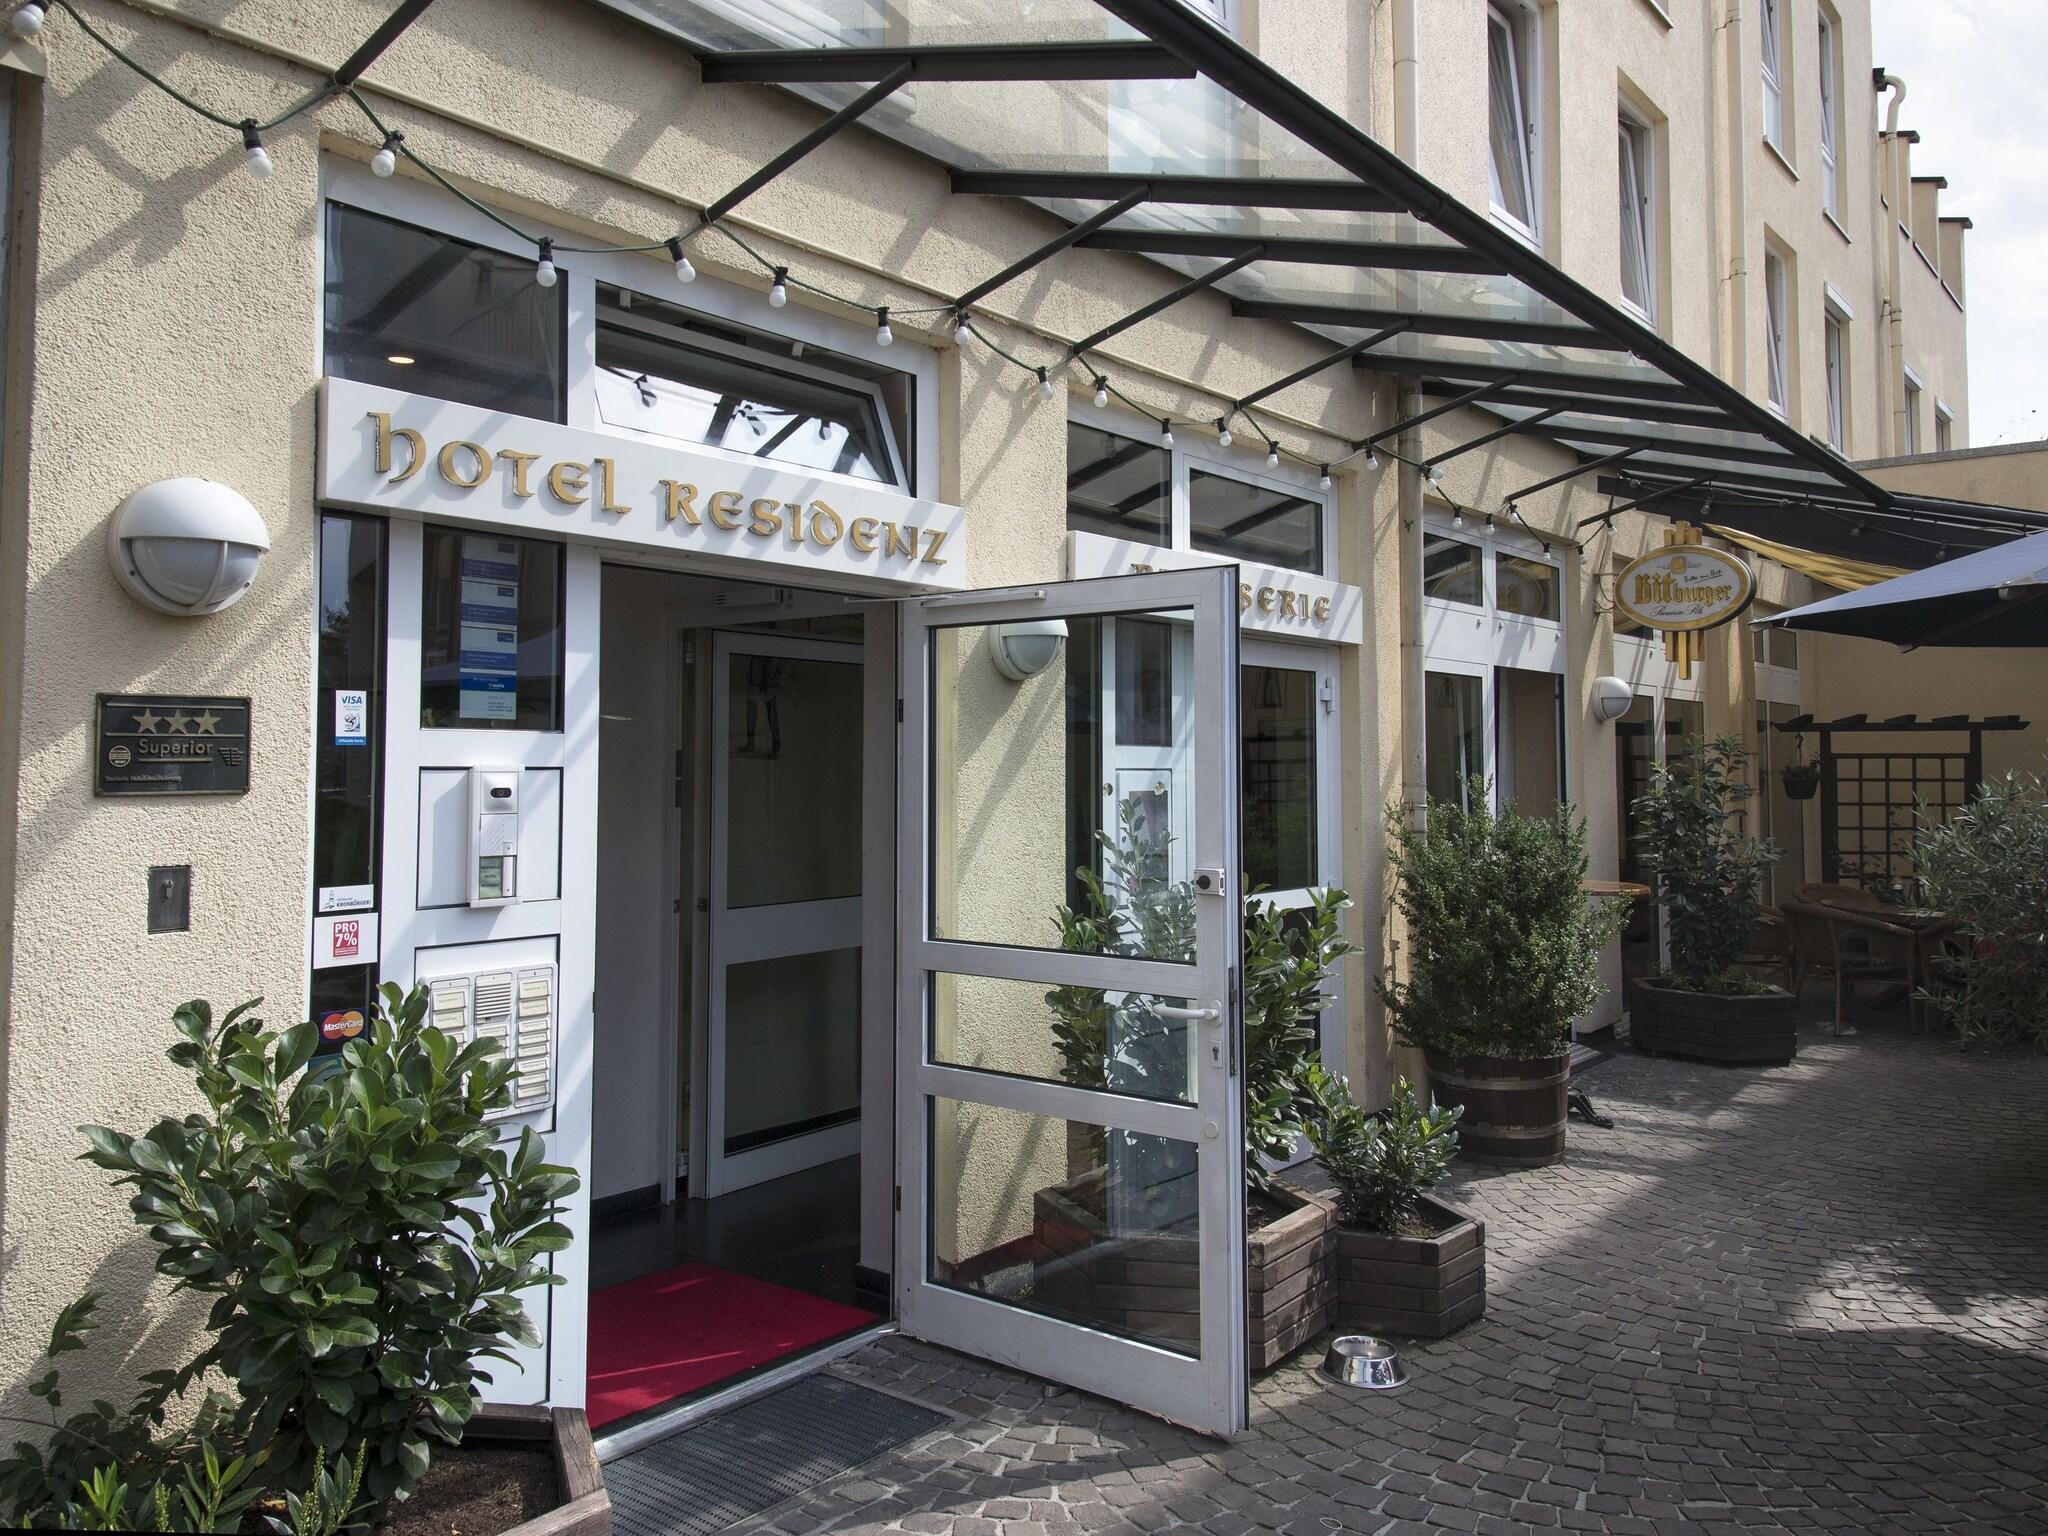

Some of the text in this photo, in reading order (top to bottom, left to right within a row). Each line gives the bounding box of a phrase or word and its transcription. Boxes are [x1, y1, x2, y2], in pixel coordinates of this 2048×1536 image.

[659, 479, 948, 566] RESIDENZ
[1634, 572, 1732, 607] Bitburger
[342, 696, 363, 704] VISA
[139, 738, 214, 758] Superior
[335, 922, 357, 934] PRO
[335, 932, 357, 947] 7%
[323, 1020, 363, 1032] MasterCard
